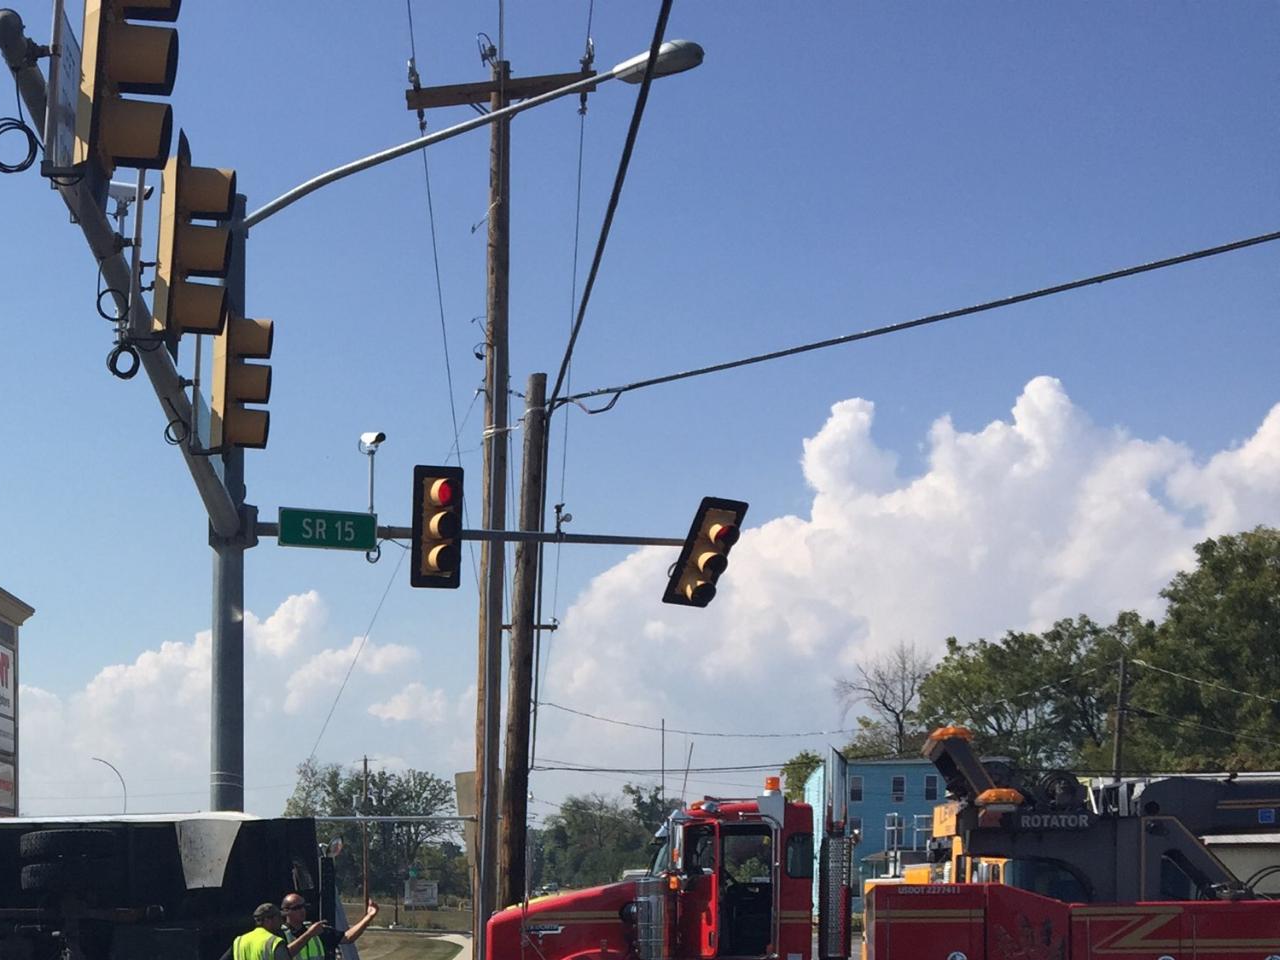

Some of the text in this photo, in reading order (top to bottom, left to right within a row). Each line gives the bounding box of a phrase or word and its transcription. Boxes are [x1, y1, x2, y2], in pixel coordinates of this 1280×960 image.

[302, 518, 355, 541] SR 15
[1021, 815, 1089, 828] ROTATOR
